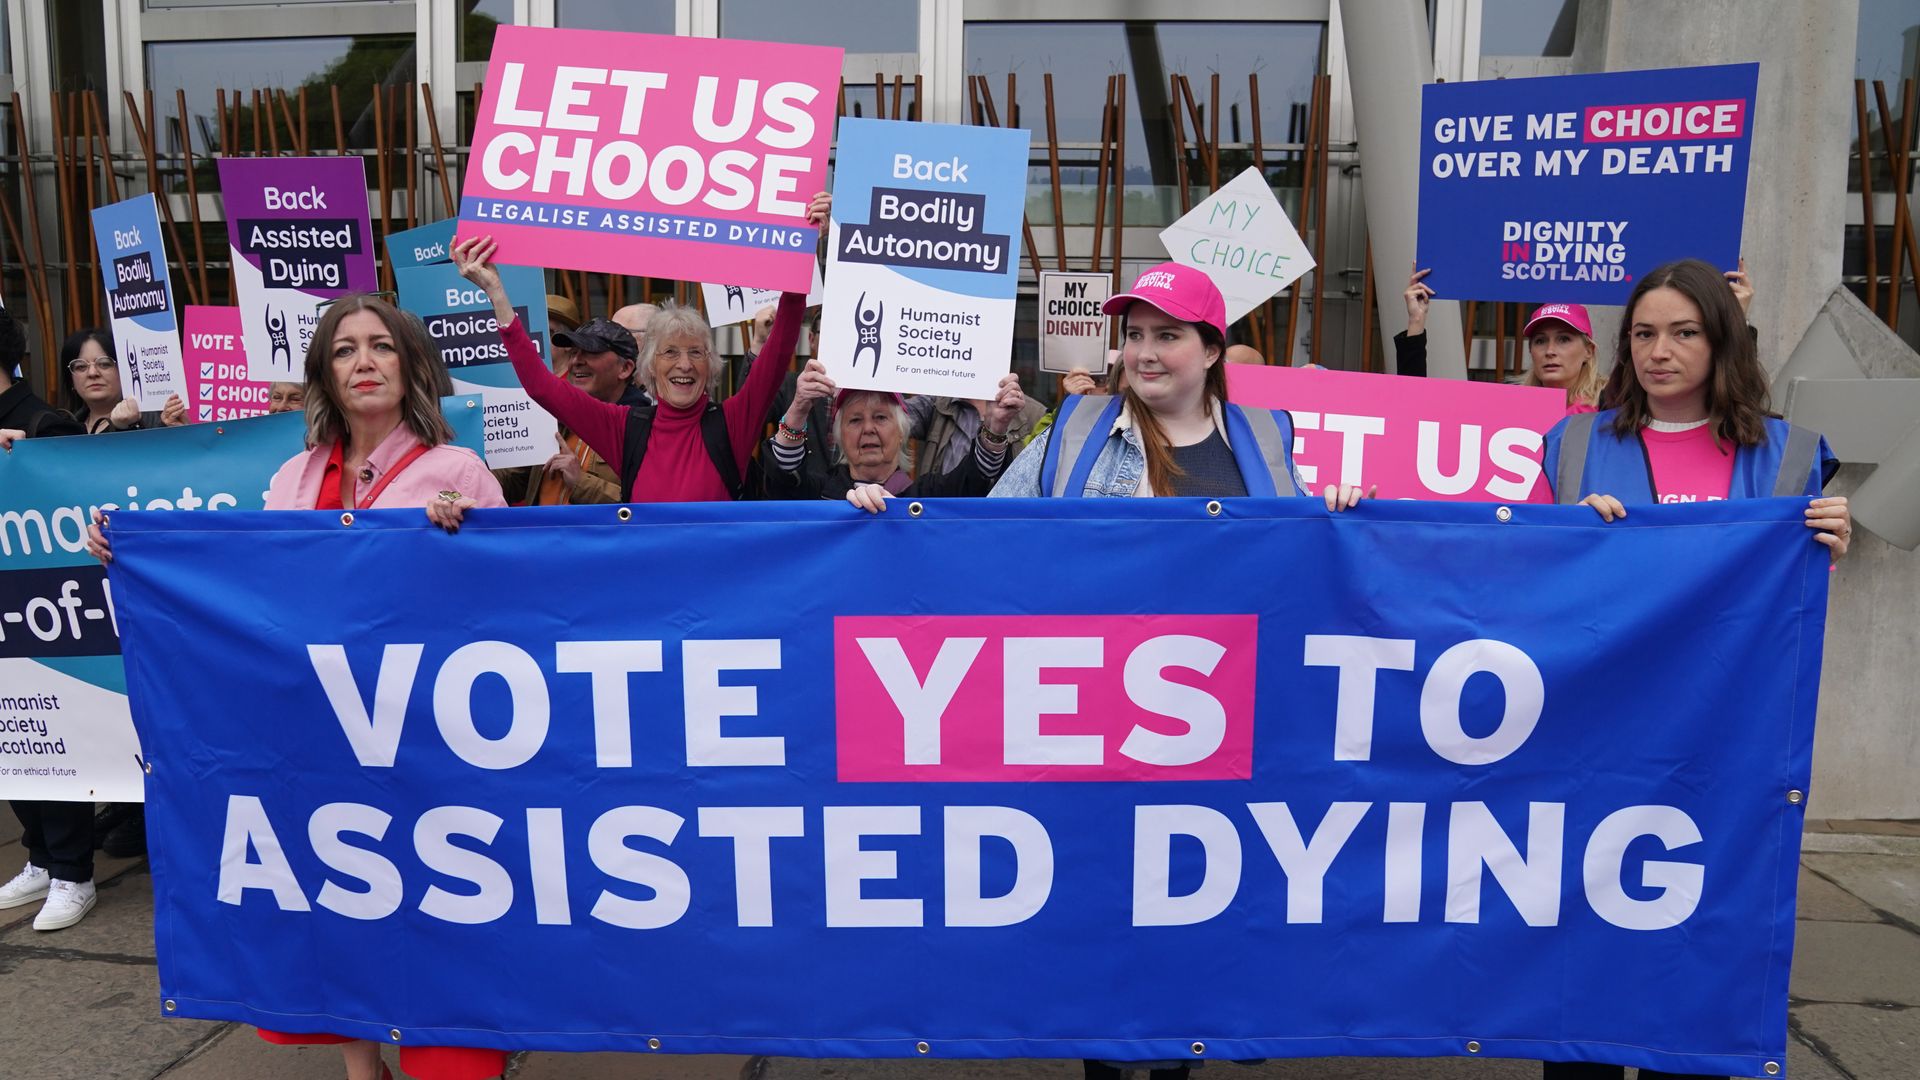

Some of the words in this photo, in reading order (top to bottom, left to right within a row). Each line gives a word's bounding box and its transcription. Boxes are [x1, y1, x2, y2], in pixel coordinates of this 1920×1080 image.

[492, 62, 668, 135] LET
[692, 76, 820, 149] US
[1434, 114, 1513, 144] GIVE
[1526, 111, 1577, 140] ME
[1589, 104, 1739, 138] CHOICE
[893, 153, 969, 183] Back
[1432, 151, 1521, 178] OVER
[1534, 149, 1590, 177] MY
[1601, 144, 1734, 175] DEATH
[482, 131, 812, 217] CHOOSE
[264, 186, 327, 210] Back
[879, 194, 975, 232] Bodily
[1208, 200, 1261, 233] MY
[250, 224, 352, 248] Assisted
[477, 202, 590, 227] LEGALISE
[600, 213, 717, 238] ASSISTED
[729, 225, 804, 248] DYING
[1502, 220, 1629, 243] DIGNITY
[114, 225, 142, 250] Back
[414, 242, 445, 262] Back
[845, 229, 1000, 271] Autonomy
[1190, 238, 1291, 280] CHOICE
[1502, 243, 1530, 262] IN
[1535, 242, 1626, 264] DYING
[117, 258, 151, 283] Bodily
[270, 258, 340, 287] Dying
[1501, 263, 1633, 283] SCOTLAND.
[114, 288, 166, 313] Autonomy
[446, 288, 493, 307] Bac
[1064, 282, 1088, 298] MY
[428, 316, 499, 338] Choice
[900, 307, 981, 327] Humanist
[1046, 320, 1103, 336] DIGNITY
[191, 333, 234, 350] VOTE
[898, 324, 961, 345] Society
[141, 345, 168, 356] Humanist
[896, 342, 973, 361] Scotland
[143, 359, 165, 371] Society
[895, 365, 909, 373] For
[923, 366, 950, 377] ethical
[951, 369, 976, 379] future
[145, 371, 170, 384] Scotland
[1416, 420, 1544, 501] US
[0, 693, 60, 711] manist
[306, 639, 786, 770] VOTE
[854, 634, 1228, 767] YES
[1303, 634, 1545, 766] TO
[0, 737, 66, 754] cotland
[12, 768, 23, 776] an
[23, 766, 51, 776] ethical
[51, 766, 77, 777] future
[216, 794, 1054, 930] ASSISTED
[1131, 800, 1706, 930] DYING
